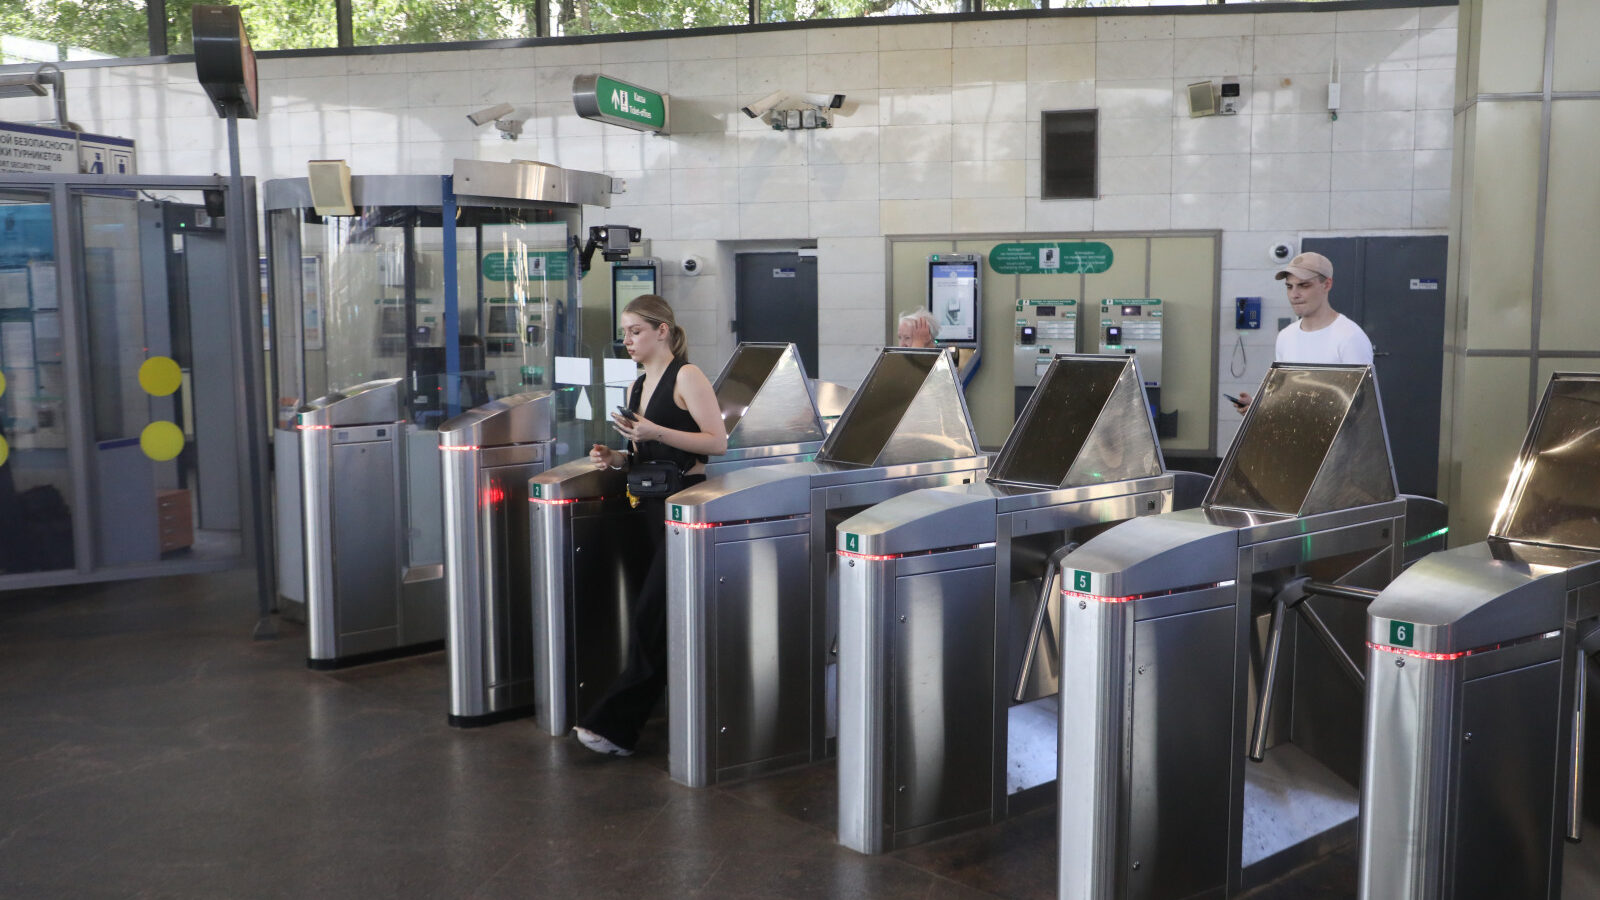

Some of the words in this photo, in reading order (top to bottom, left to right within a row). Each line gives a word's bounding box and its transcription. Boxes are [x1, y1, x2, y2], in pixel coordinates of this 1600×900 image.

[14, 136, 74, 151] БЕЗОПАСНОСТИ
[13, 148, 63, 162] ТУРНИКЕТОВ
[535, 486, 540, 496] 2
[674, 508, 680, 519] 3
[849, 536, 855, 549] 4
[1079, 575, 1086, 588] 5
[1397, 625, 1406, 641] 6
